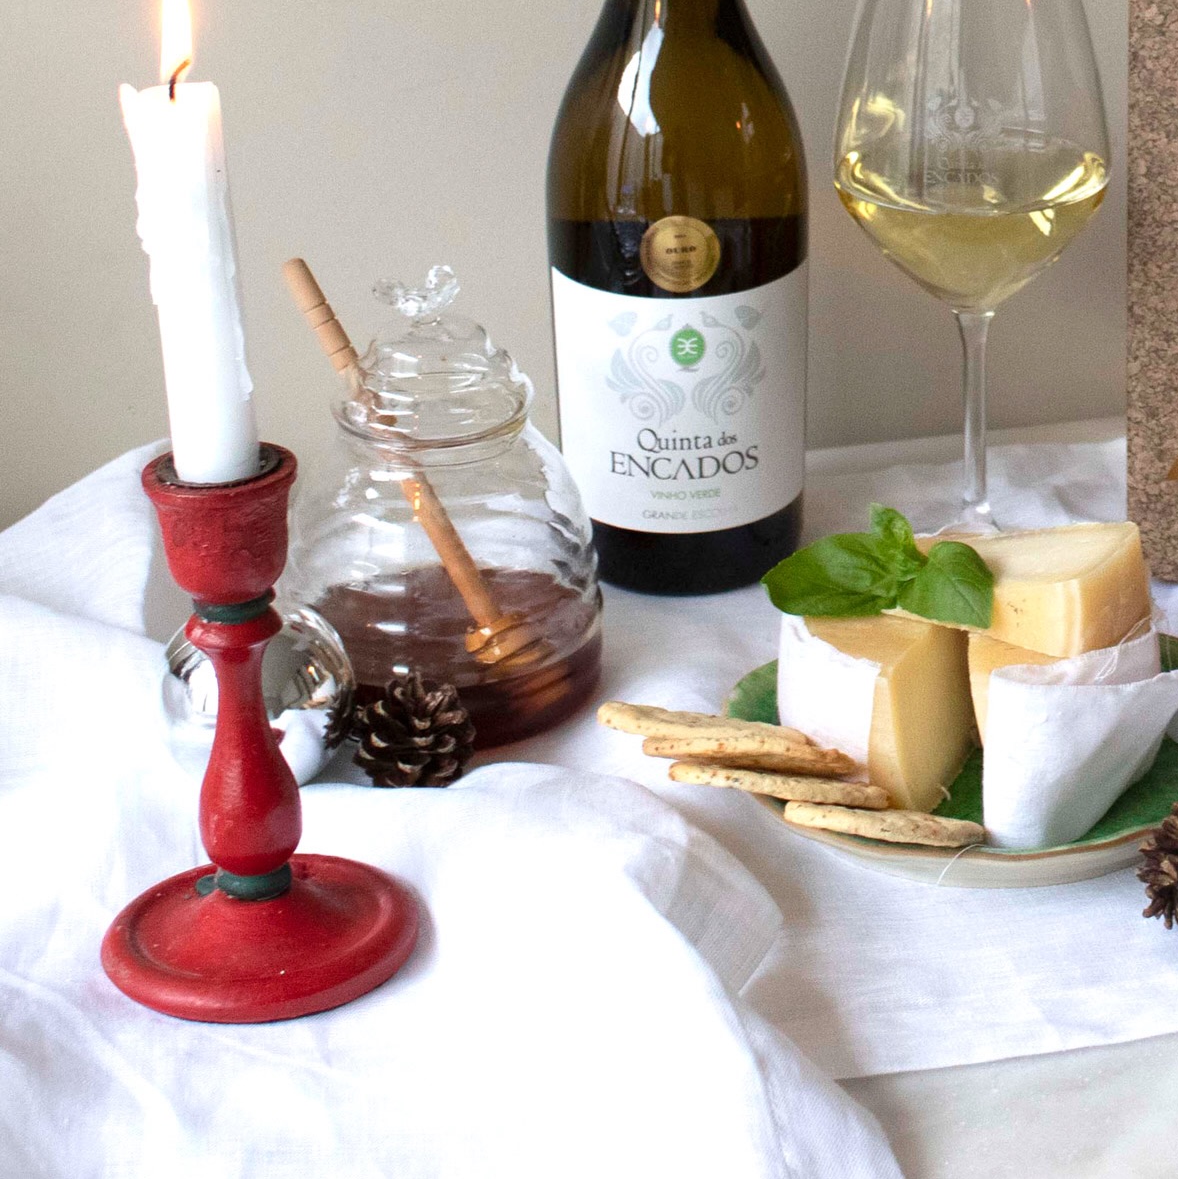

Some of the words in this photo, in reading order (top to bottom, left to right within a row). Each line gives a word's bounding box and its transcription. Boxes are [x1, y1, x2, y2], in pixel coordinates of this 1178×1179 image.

[636, 427, 713, 453] Quinta
[717, 430, 738, 447] dos
[609, 444, 760, 481] ENCADOS
[650, 490, 687, 501] VINHO
[689, 487, 721, 500] VERDE
[642, 509, 688, 520] GRANDE
